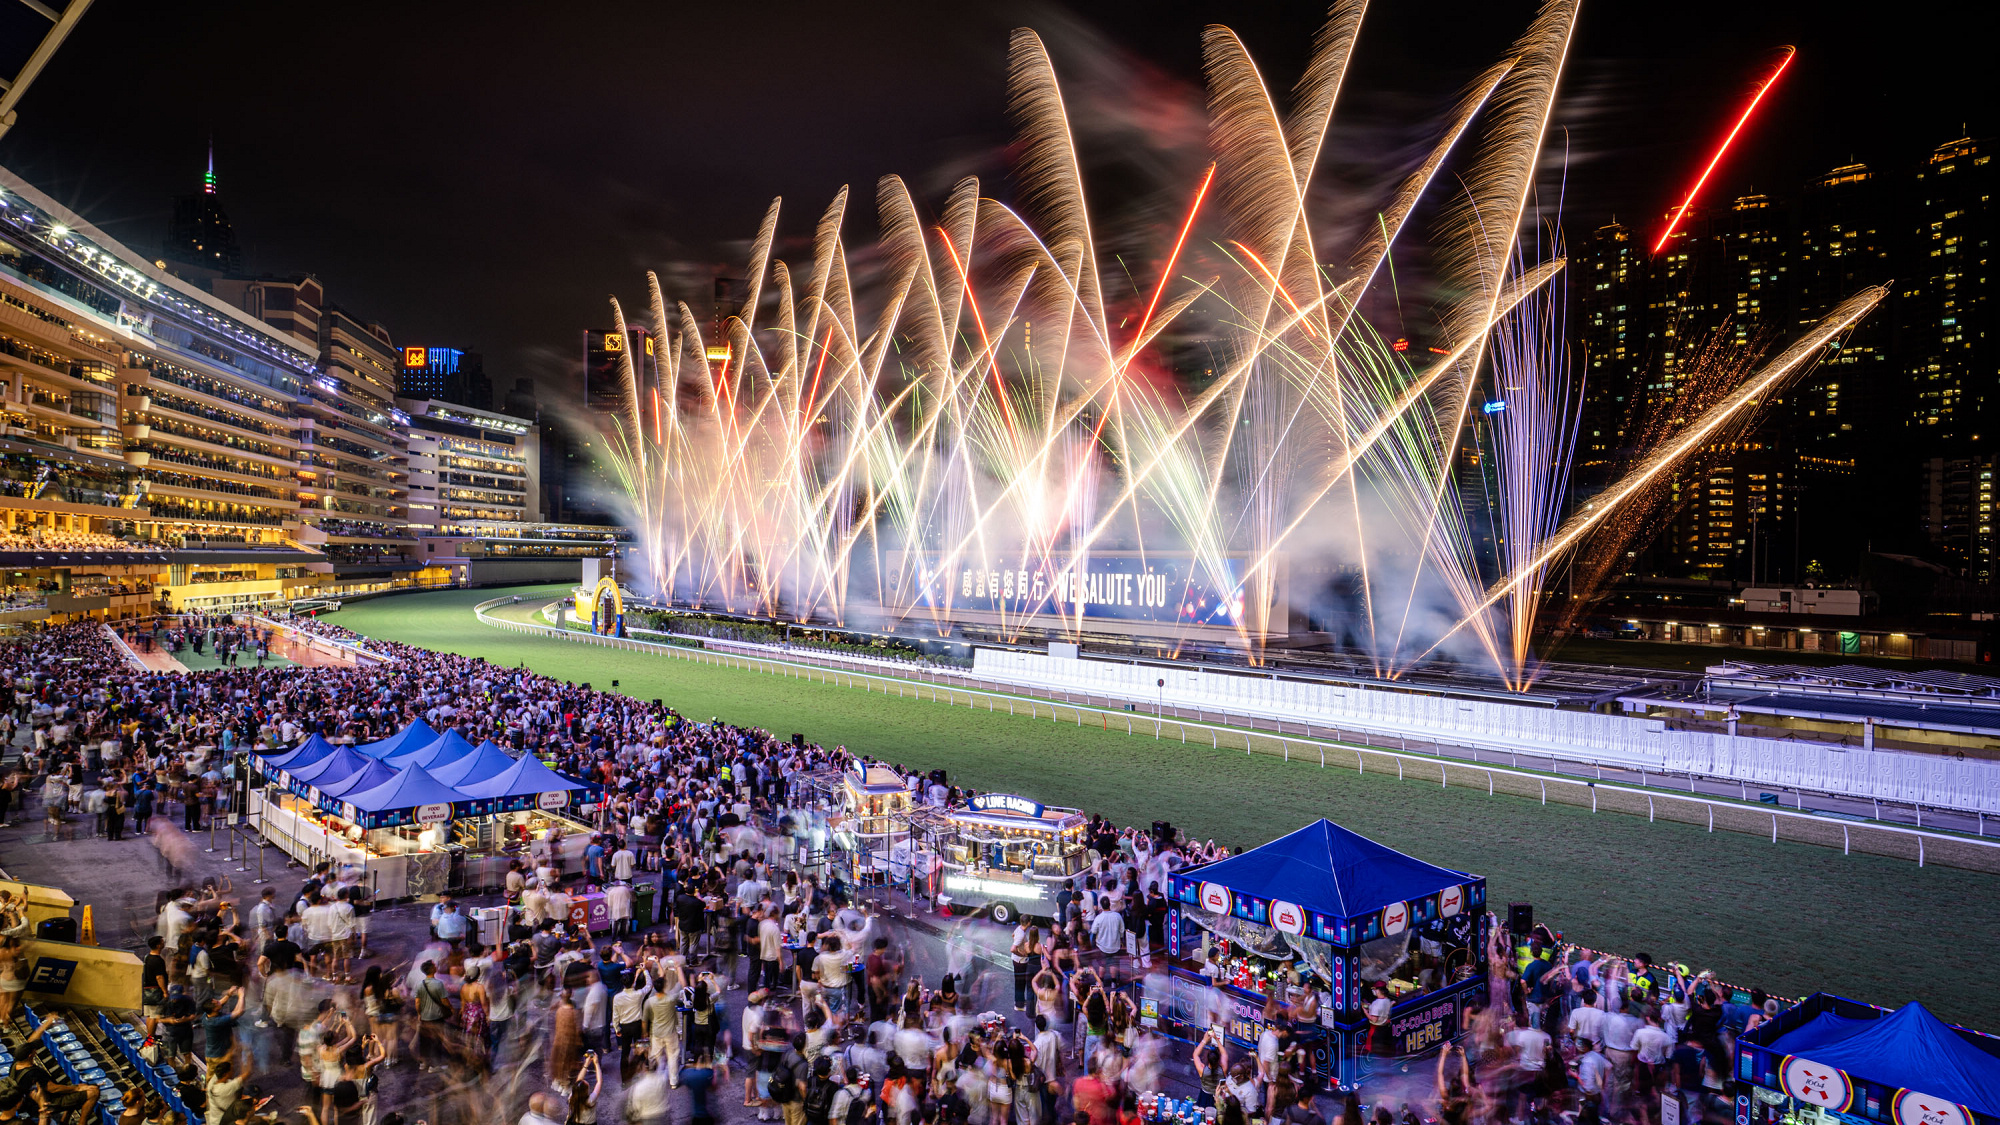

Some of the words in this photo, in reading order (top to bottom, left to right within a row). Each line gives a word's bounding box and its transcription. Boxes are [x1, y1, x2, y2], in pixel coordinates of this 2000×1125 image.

[1058, 573, 1076, 603] WE
[1081, 573, 1132, 606] SALUTE
[1137, 574, 1166, 608] YOU
[986, 796, 1006, 809] LOVE
[1006, 797, 1036, 815] RACING
[422, 813, 446, 821] BEVERAGE
[32, 966, 53, 983] E
[49, 977, 67, 985] Zone
[1392, 1011, 1431, 1037] ICE-COLD
[1432, 1002, 1454, 1019] BEER
[1406, 1020, 1442, 1053] HERE
